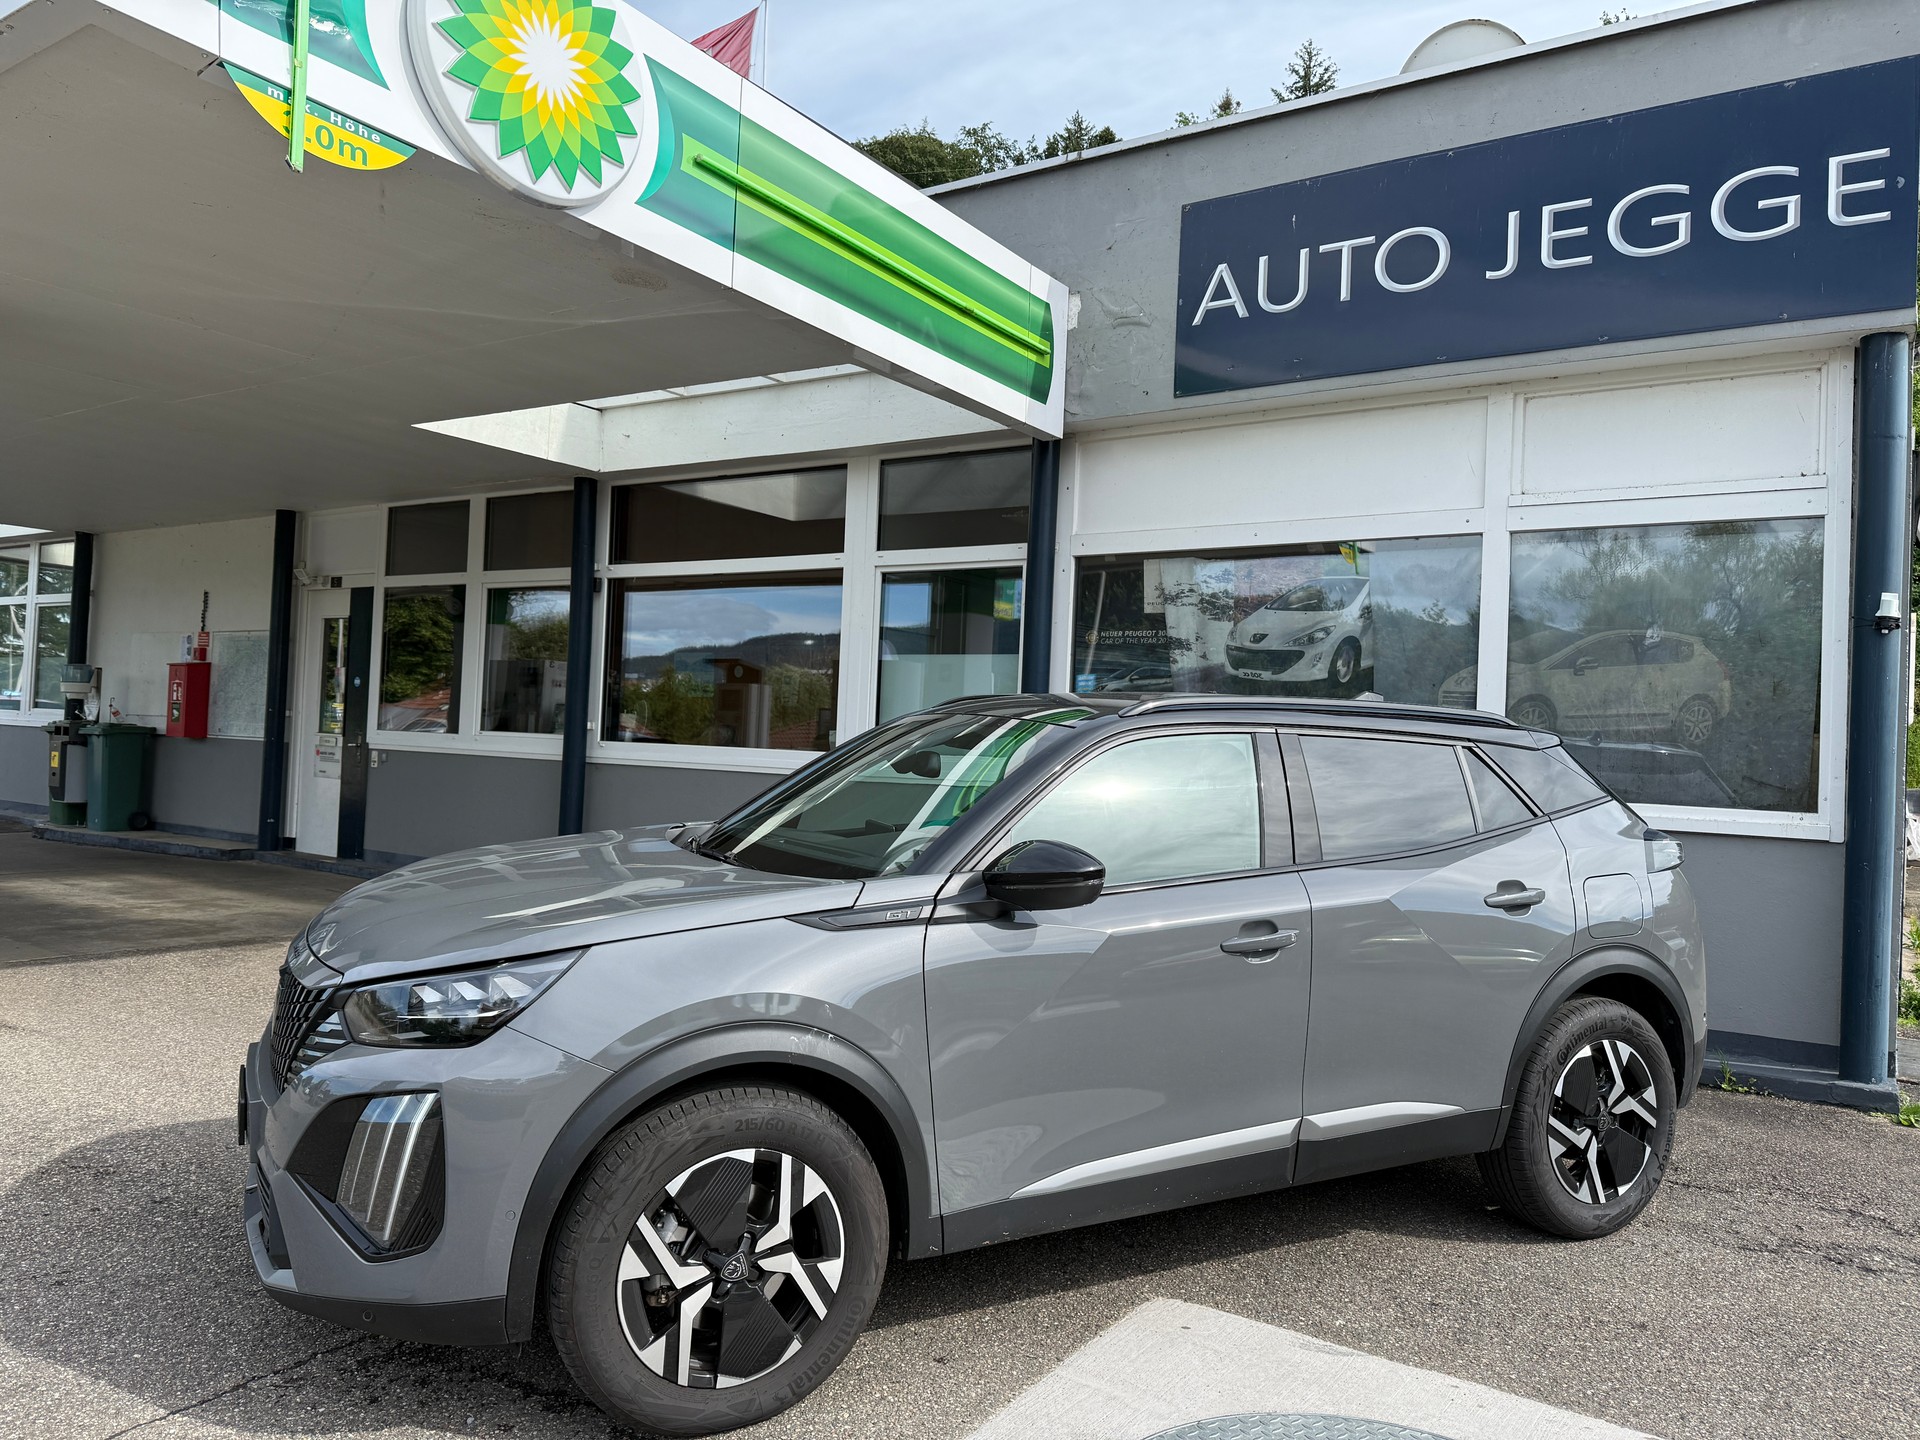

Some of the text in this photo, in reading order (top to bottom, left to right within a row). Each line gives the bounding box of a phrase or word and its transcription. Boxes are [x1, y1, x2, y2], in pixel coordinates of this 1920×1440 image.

[268, 86, 381, 143] mx. Höhe
[283, 110, 368, 167] .0m
[1192, 147, 1892, 326] AUTO JEGGE
[1557, 1017, 1608, 1066] Continental
[734, 1117, 786, 1133] 215/60
[787, 1121, 798, 1136] R
[785, 1295, 867, 1396] Continental
